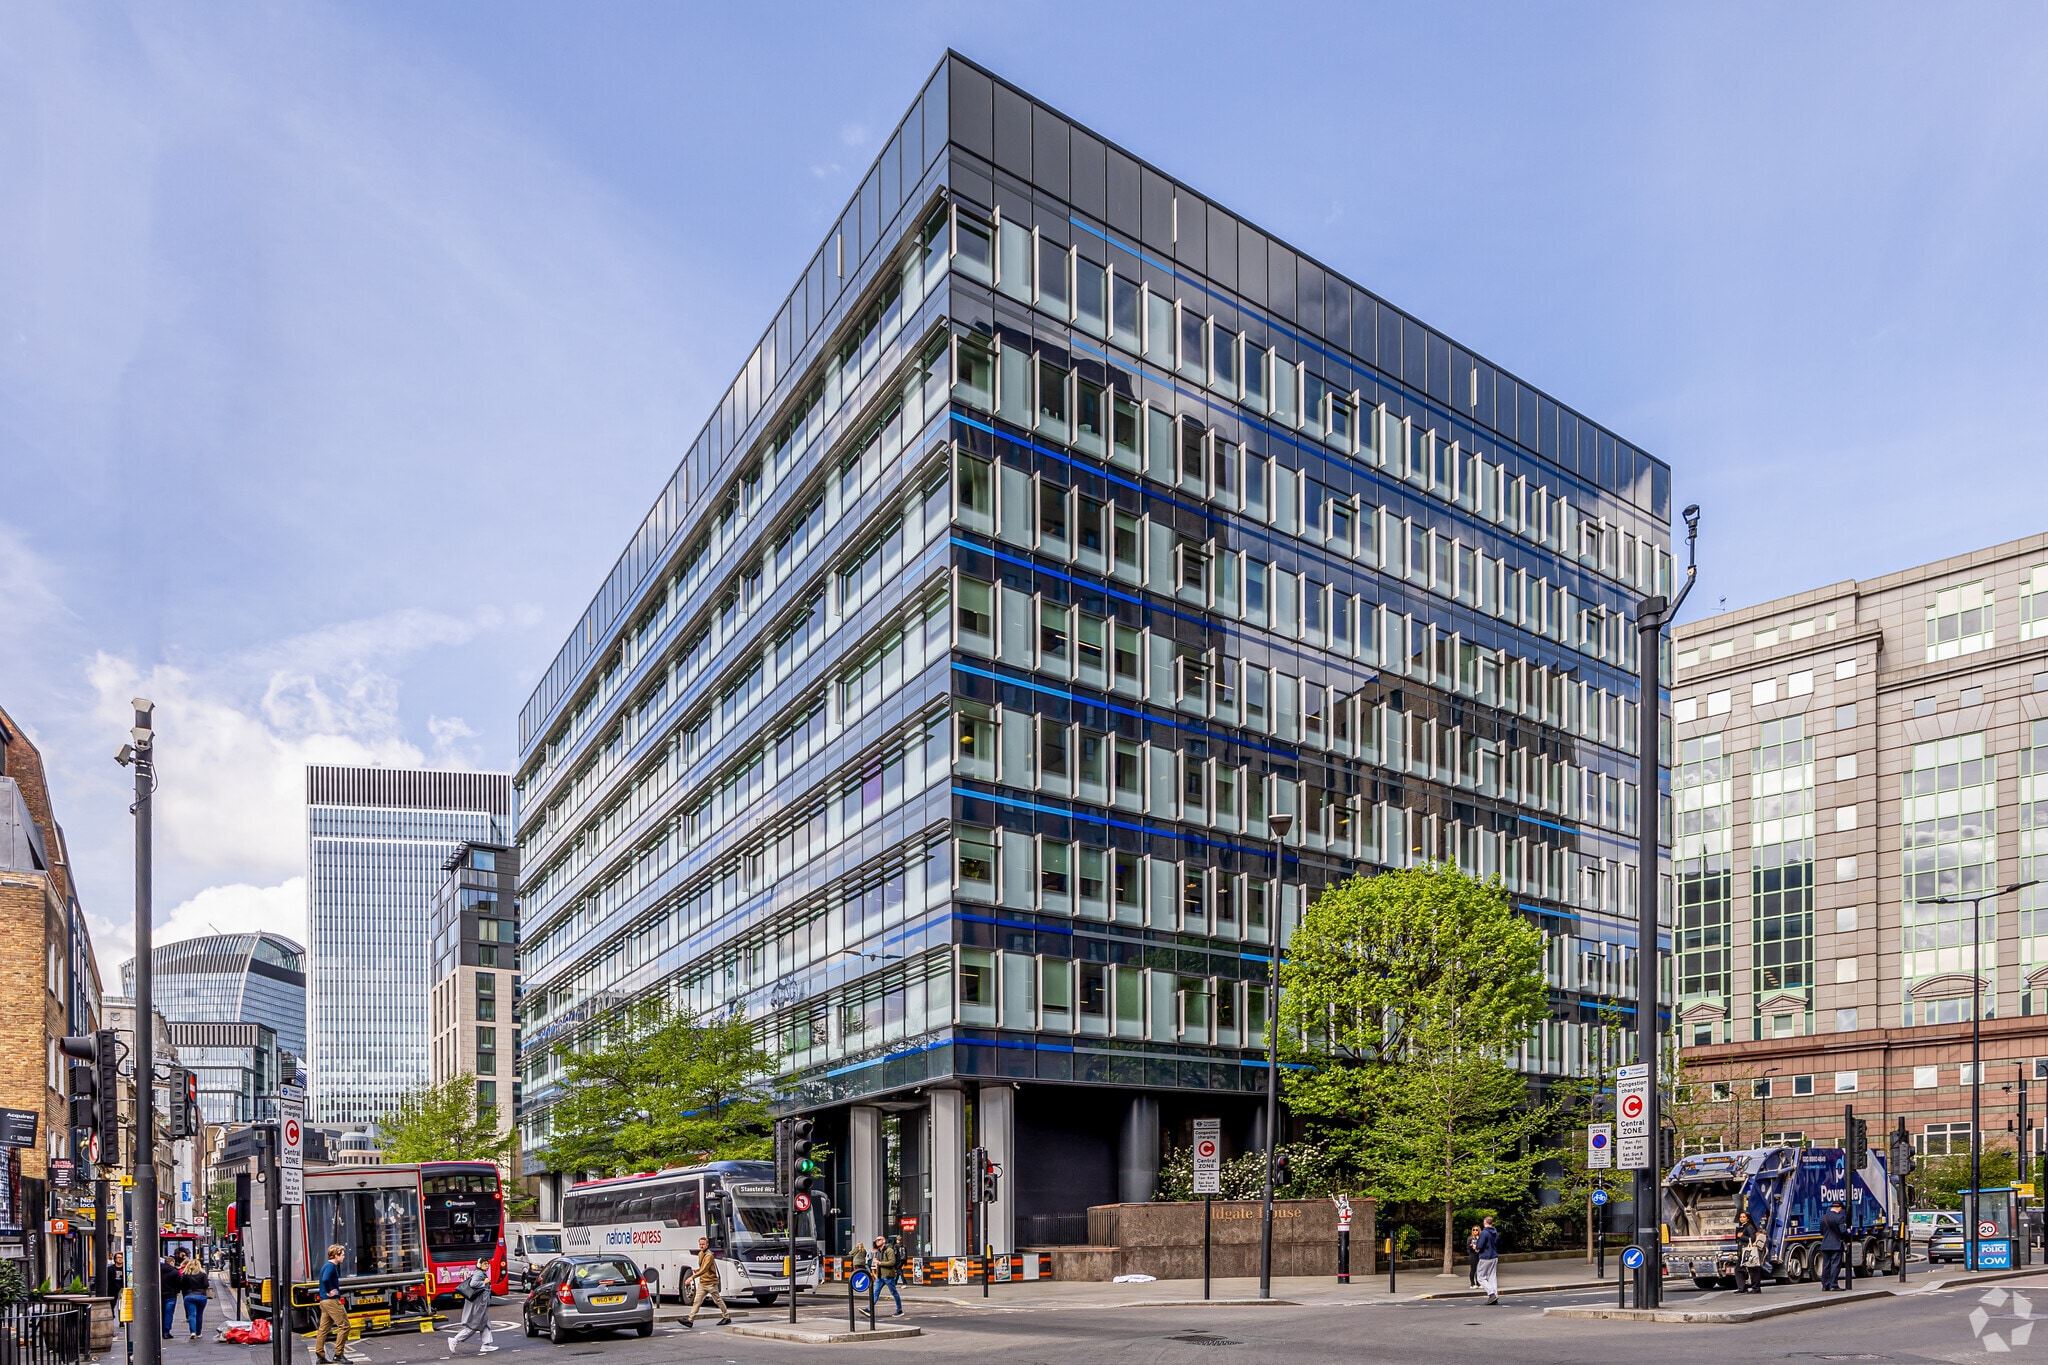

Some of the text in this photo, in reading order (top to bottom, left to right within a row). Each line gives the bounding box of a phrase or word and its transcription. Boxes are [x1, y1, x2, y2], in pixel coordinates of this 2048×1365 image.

[1618, 1080, 1647, 1088] Congestion
[281, 1102, 303, 1111] Congestion
[6, 1112, 35, 1120] Acquired
[284, 1110, 300, 1119] charging
[1620, 1119, 1645, 1128] Central
[1622, 1127, 1642, 1135] ZONE
[284, 1147, 300, 1157] Central
[285, 1156, 299, 1165] ZONE
[454, 1213, 468, 1223] 25
[606, 1226, 662, 1249] national express
[1969, 1257, 2007, 1265] LOW
